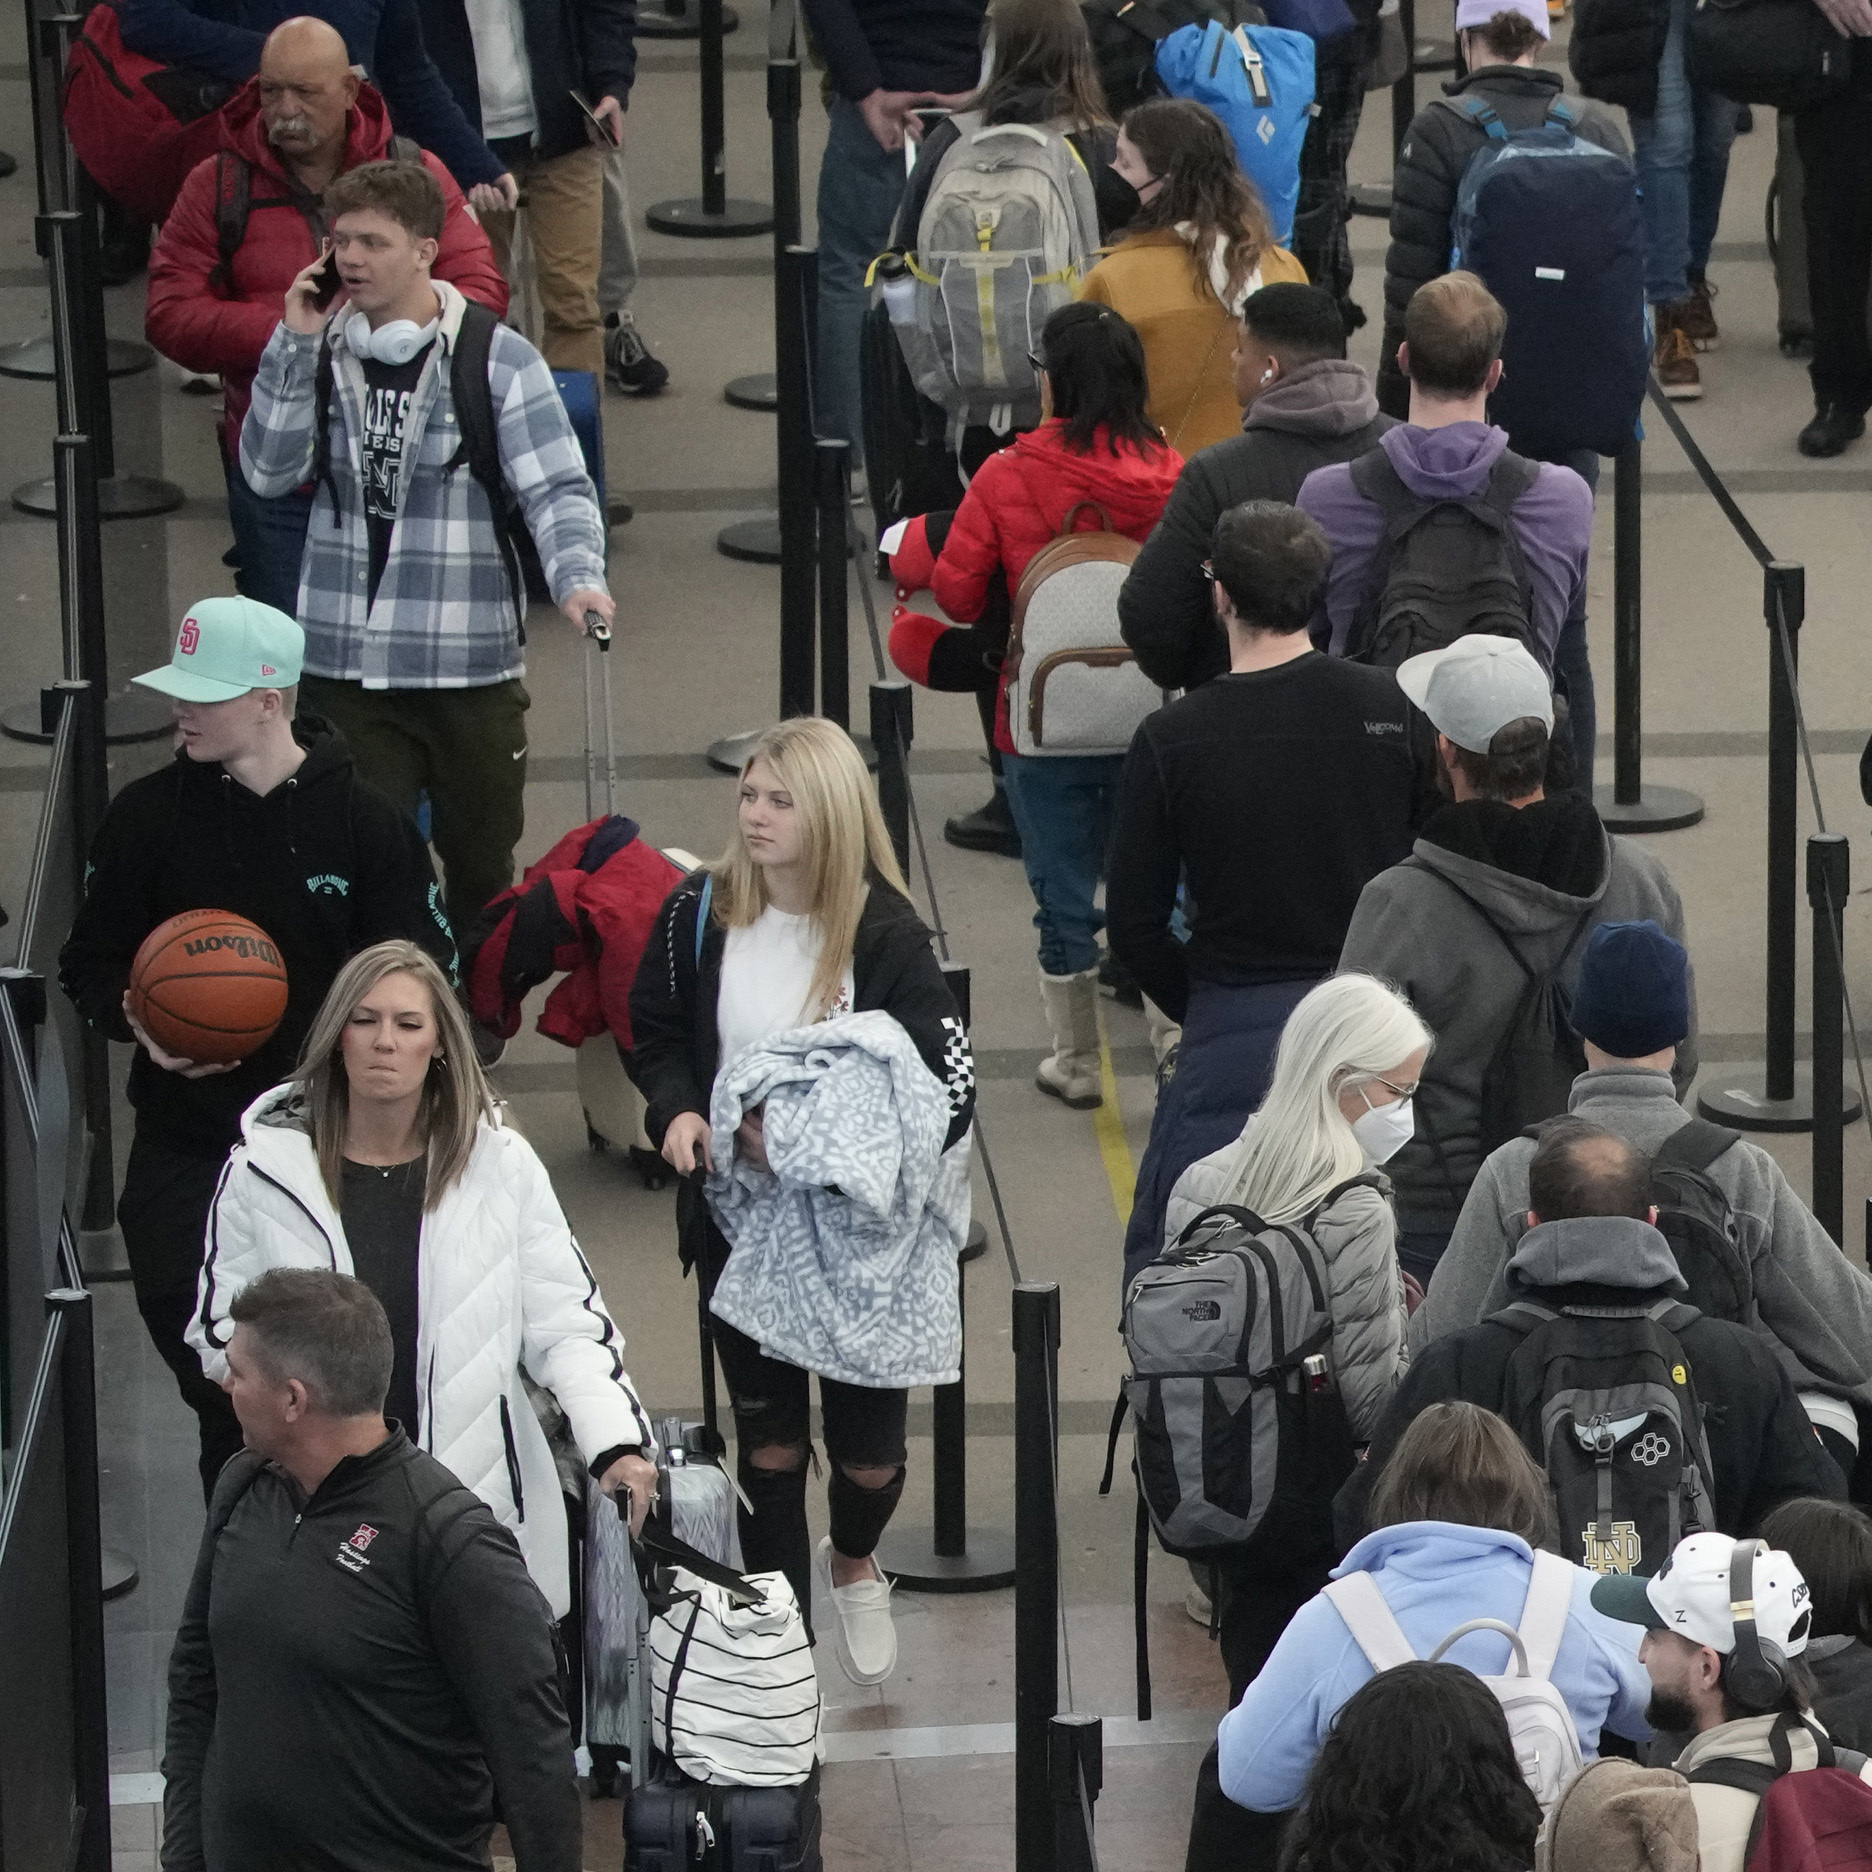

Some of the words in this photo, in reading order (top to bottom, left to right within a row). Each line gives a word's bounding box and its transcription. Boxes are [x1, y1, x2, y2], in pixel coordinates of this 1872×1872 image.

[183, 934, 280, 966] Wilson
[1194, 1300, 1210, 1310] THE
[1182, 1307, 1211, 1316] NORTH
[1189, 1313, 1211, 1322] FACE
